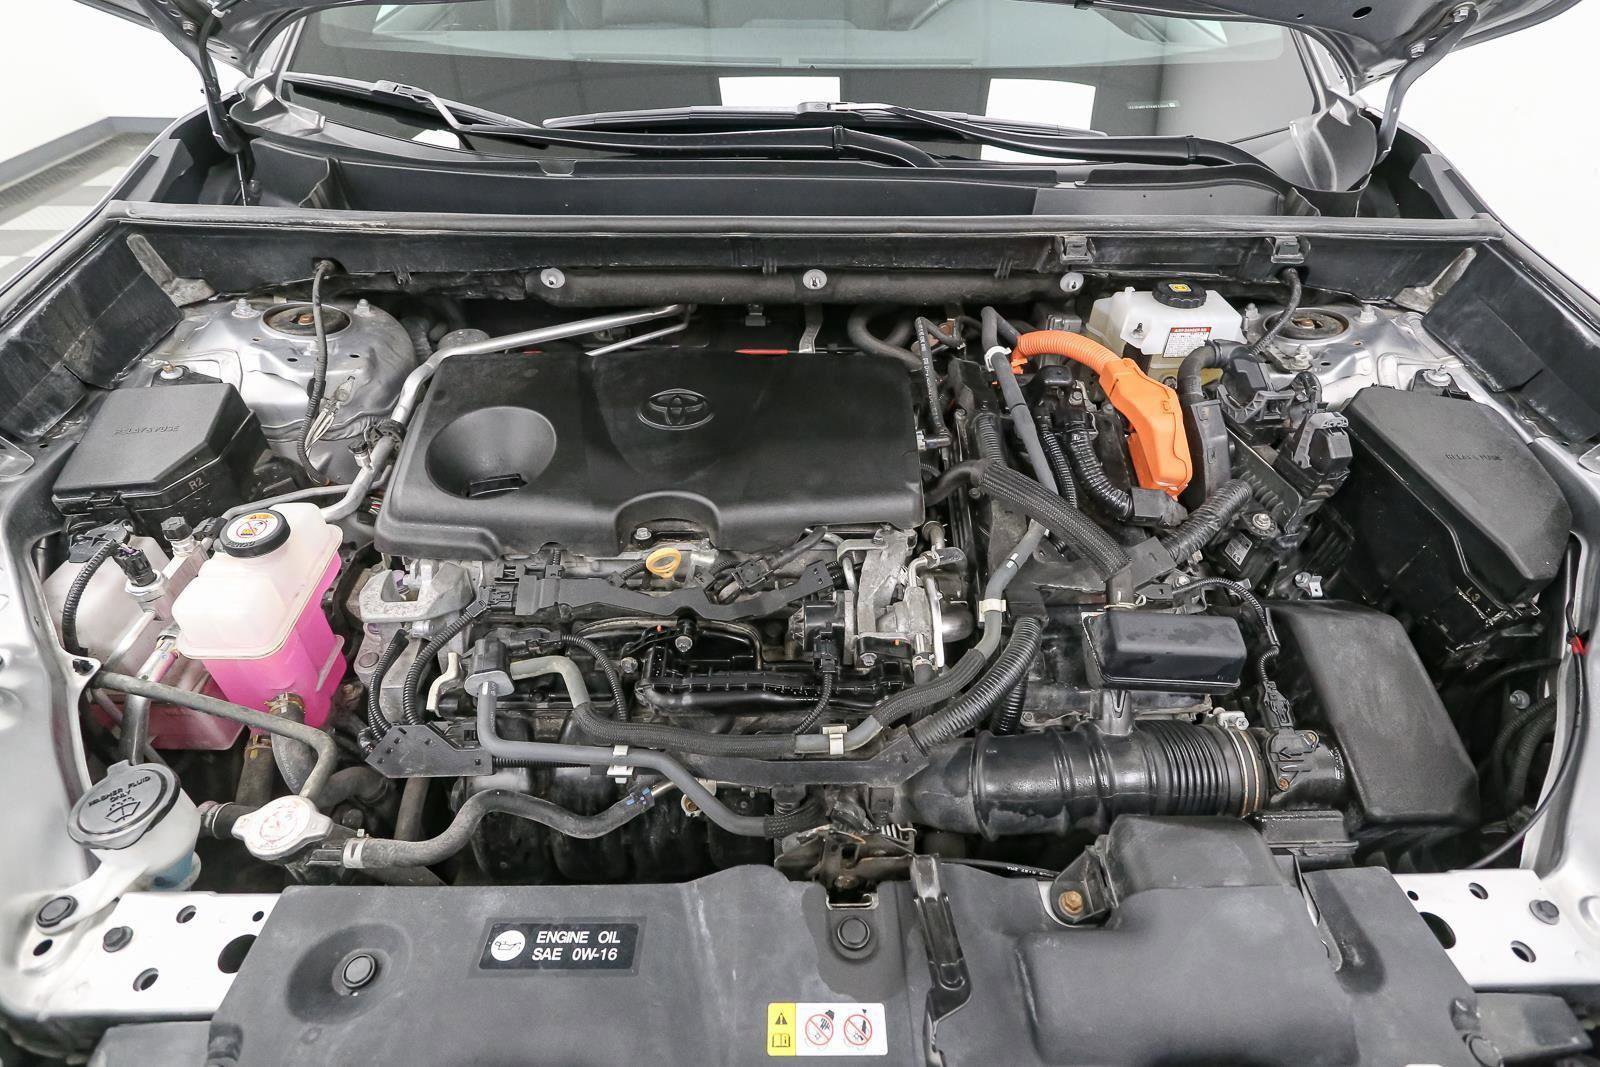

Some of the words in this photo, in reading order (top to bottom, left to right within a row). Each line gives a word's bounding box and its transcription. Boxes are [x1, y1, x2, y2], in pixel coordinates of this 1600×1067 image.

[188, 477, 204, 490] R2
[1465, 586, 1480, 601] L3
[128, 776, 151, 789] FLUID
[110, 789, 131, 803] ONLY
[535, 931, 590, 944] ENGINE
[597, 931, 621, 944] OIL
[531, 947, 563, 961] SAE
[571, 947, 618, 961] 0W-16
